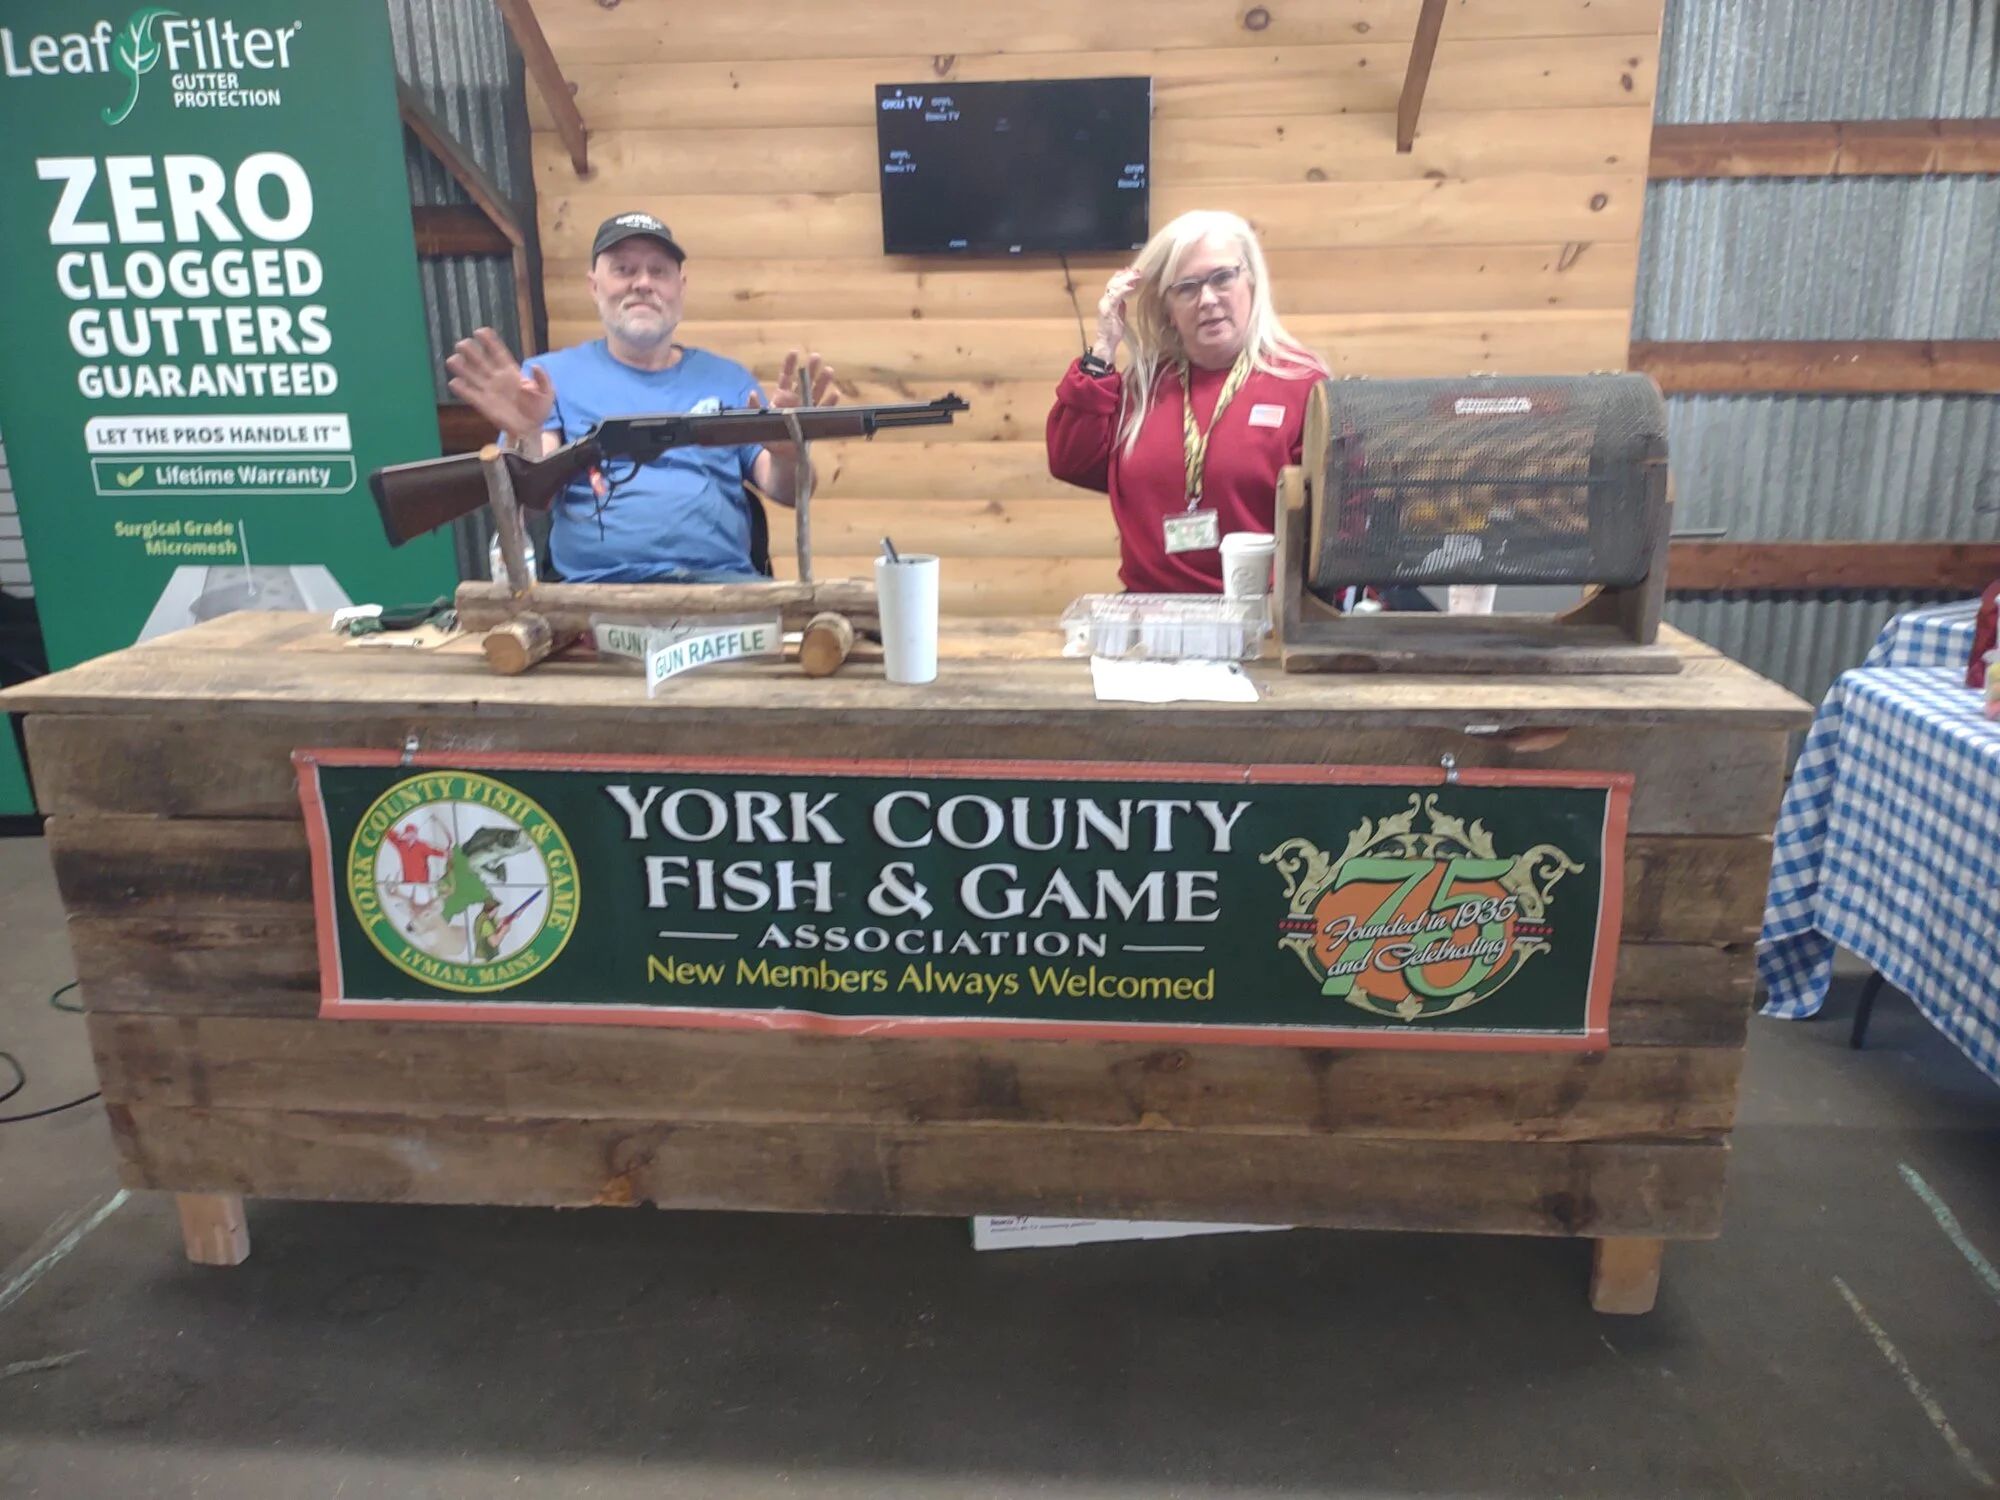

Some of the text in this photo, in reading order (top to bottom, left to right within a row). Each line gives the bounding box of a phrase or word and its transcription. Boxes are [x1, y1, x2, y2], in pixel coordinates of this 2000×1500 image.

[1, 20, 113, 78] Leaf
[171, 73, 239, 91] GUTTER
[173, 89, 281, 108] PROTECTION
[906, 96, 924, 110] TV
[35, 151, 314, 246] ZERO
[56, 248, 324, 301] CLOGGED
[68, 304, 333, 358] GUTTERS
[77, 362, 339, 399] GUARANTEED
[96, 428, 127, 445] LET
[132, 427, 170, 444] THE
[173, 426, 225, 444] PROS
[230, 425, 309, 443] HANDLE
[155, 465, 331, 488] Lifetime Warranty
[114, 519, 235, 539] Surgical Grade
[145, 538, 238, 556] Micromesh
[607, 628, 643, 658] GUN
[655, 646, 684, 678] GUN
[688, 628, 766, 665] RAFFLE
[604, 784, 1253, 853] YORK COUNTY
[361, 777, 455, 848] COUNTY
[463, 780, 533, 823] FISH
[530, 822, 553, 845] &
[547, 848, 575, 932] GAME
[644, 855, 1222, 923] FISH & GAME
[756, 922, 1108, 958] ASSOCIATION
[1320, 856, 1518, 999] 75
[1324, 911, 1428, 951] Founded
[1424, 911, 1448, 932] in
[478, 948, 542, 985] MAINE
[1326, 937, 1508, 977] and Celebrating
[646, 954, 1216, 1004] New Members Always Welcomed
